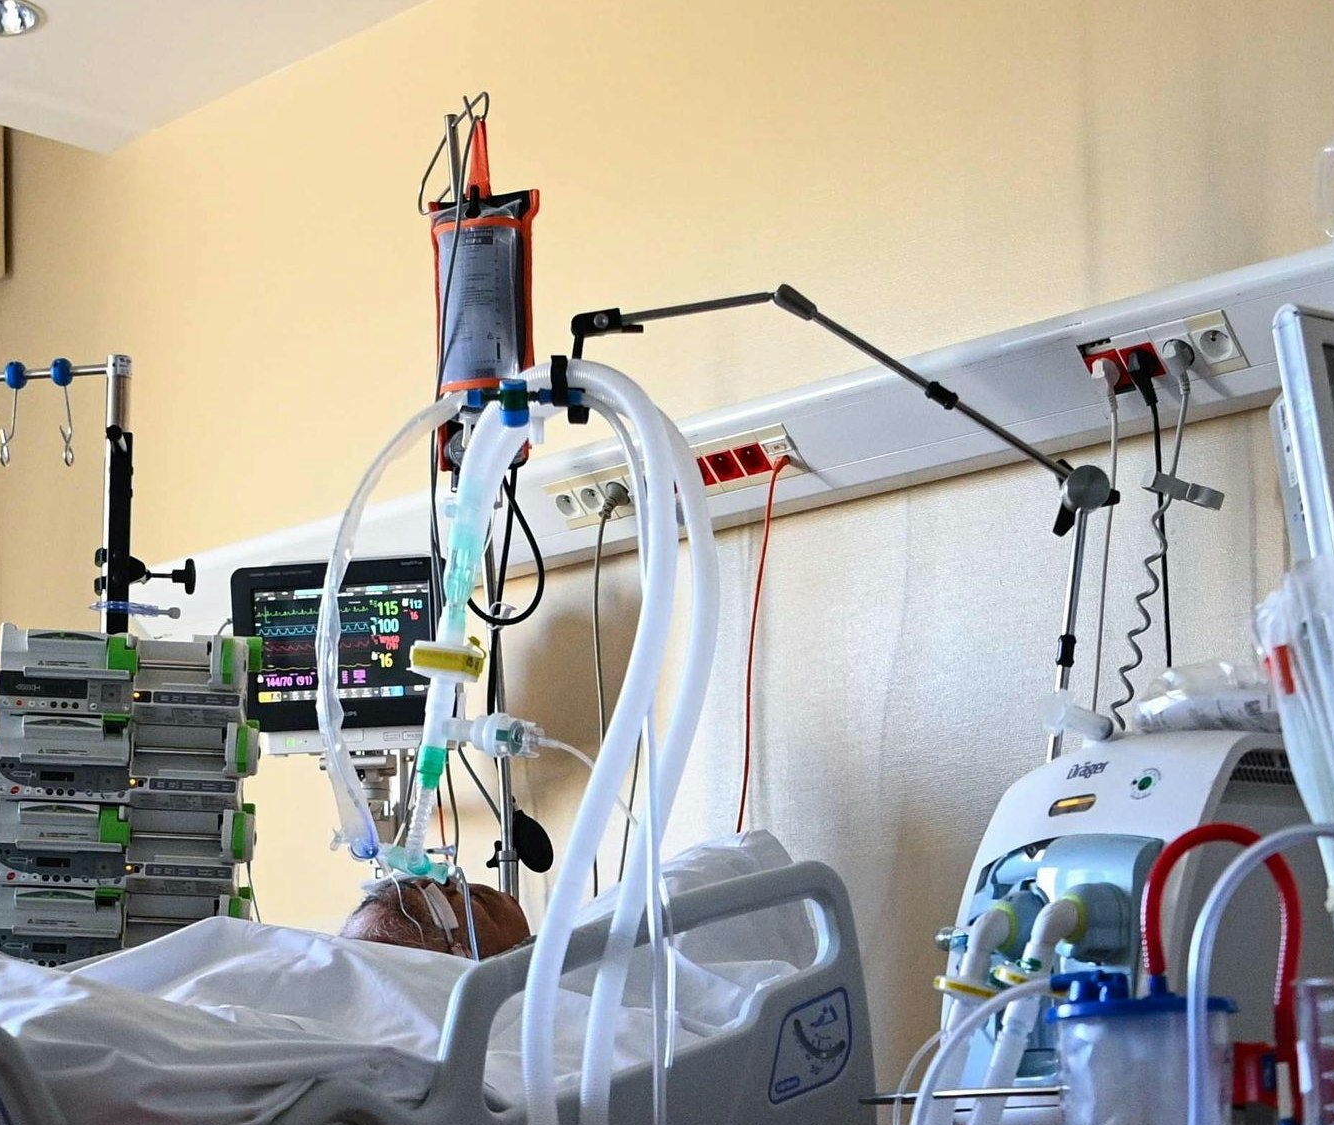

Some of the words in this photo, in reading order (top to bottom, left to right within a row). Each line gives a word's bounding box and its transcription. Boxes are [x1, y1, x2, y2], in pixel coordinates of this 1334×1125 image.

[378, 601, 399, 616] 115
[378, 618, 399, 633] 100
[379, 653, 393, 668] 16
[266, 677, 293, 688] 144/70
[296, 675, 313, 687] (91)
[1067, 761, 1109, 780] Dräger
